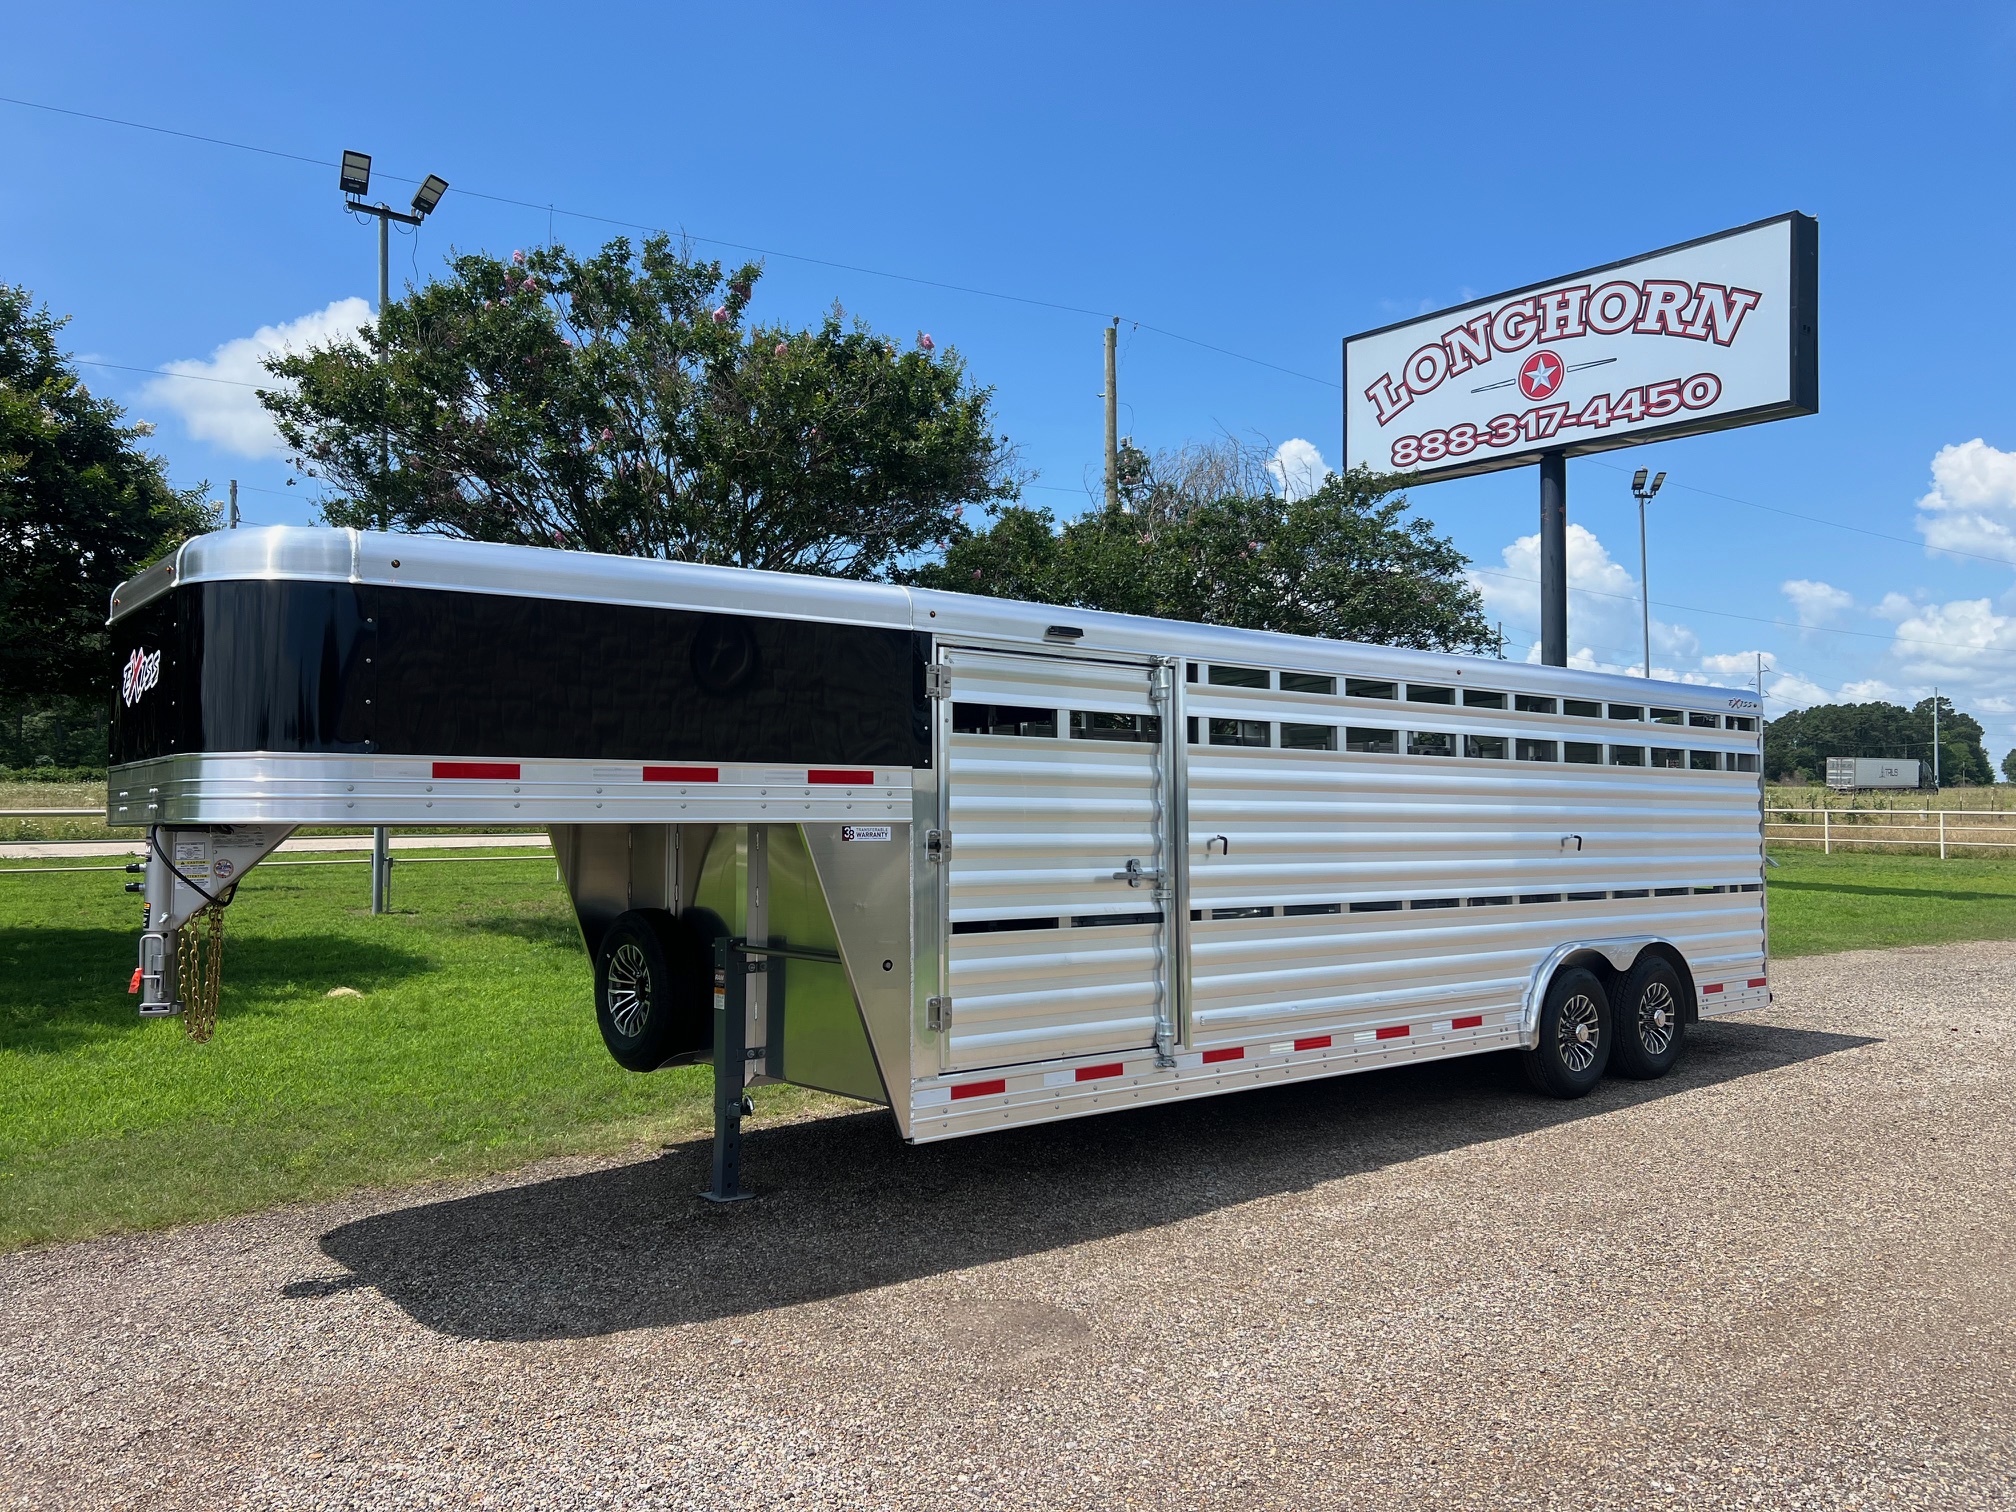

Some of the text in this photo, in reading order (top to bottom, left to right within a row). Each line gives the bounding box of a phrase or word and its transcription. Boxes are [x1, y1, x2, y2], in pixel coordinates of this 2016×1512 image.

[1364, 280, 1762, 426] LONGHORN
[1391, 373, 1722, 467] 888-317-4450
[123, 647, 160, 708] EXISS
